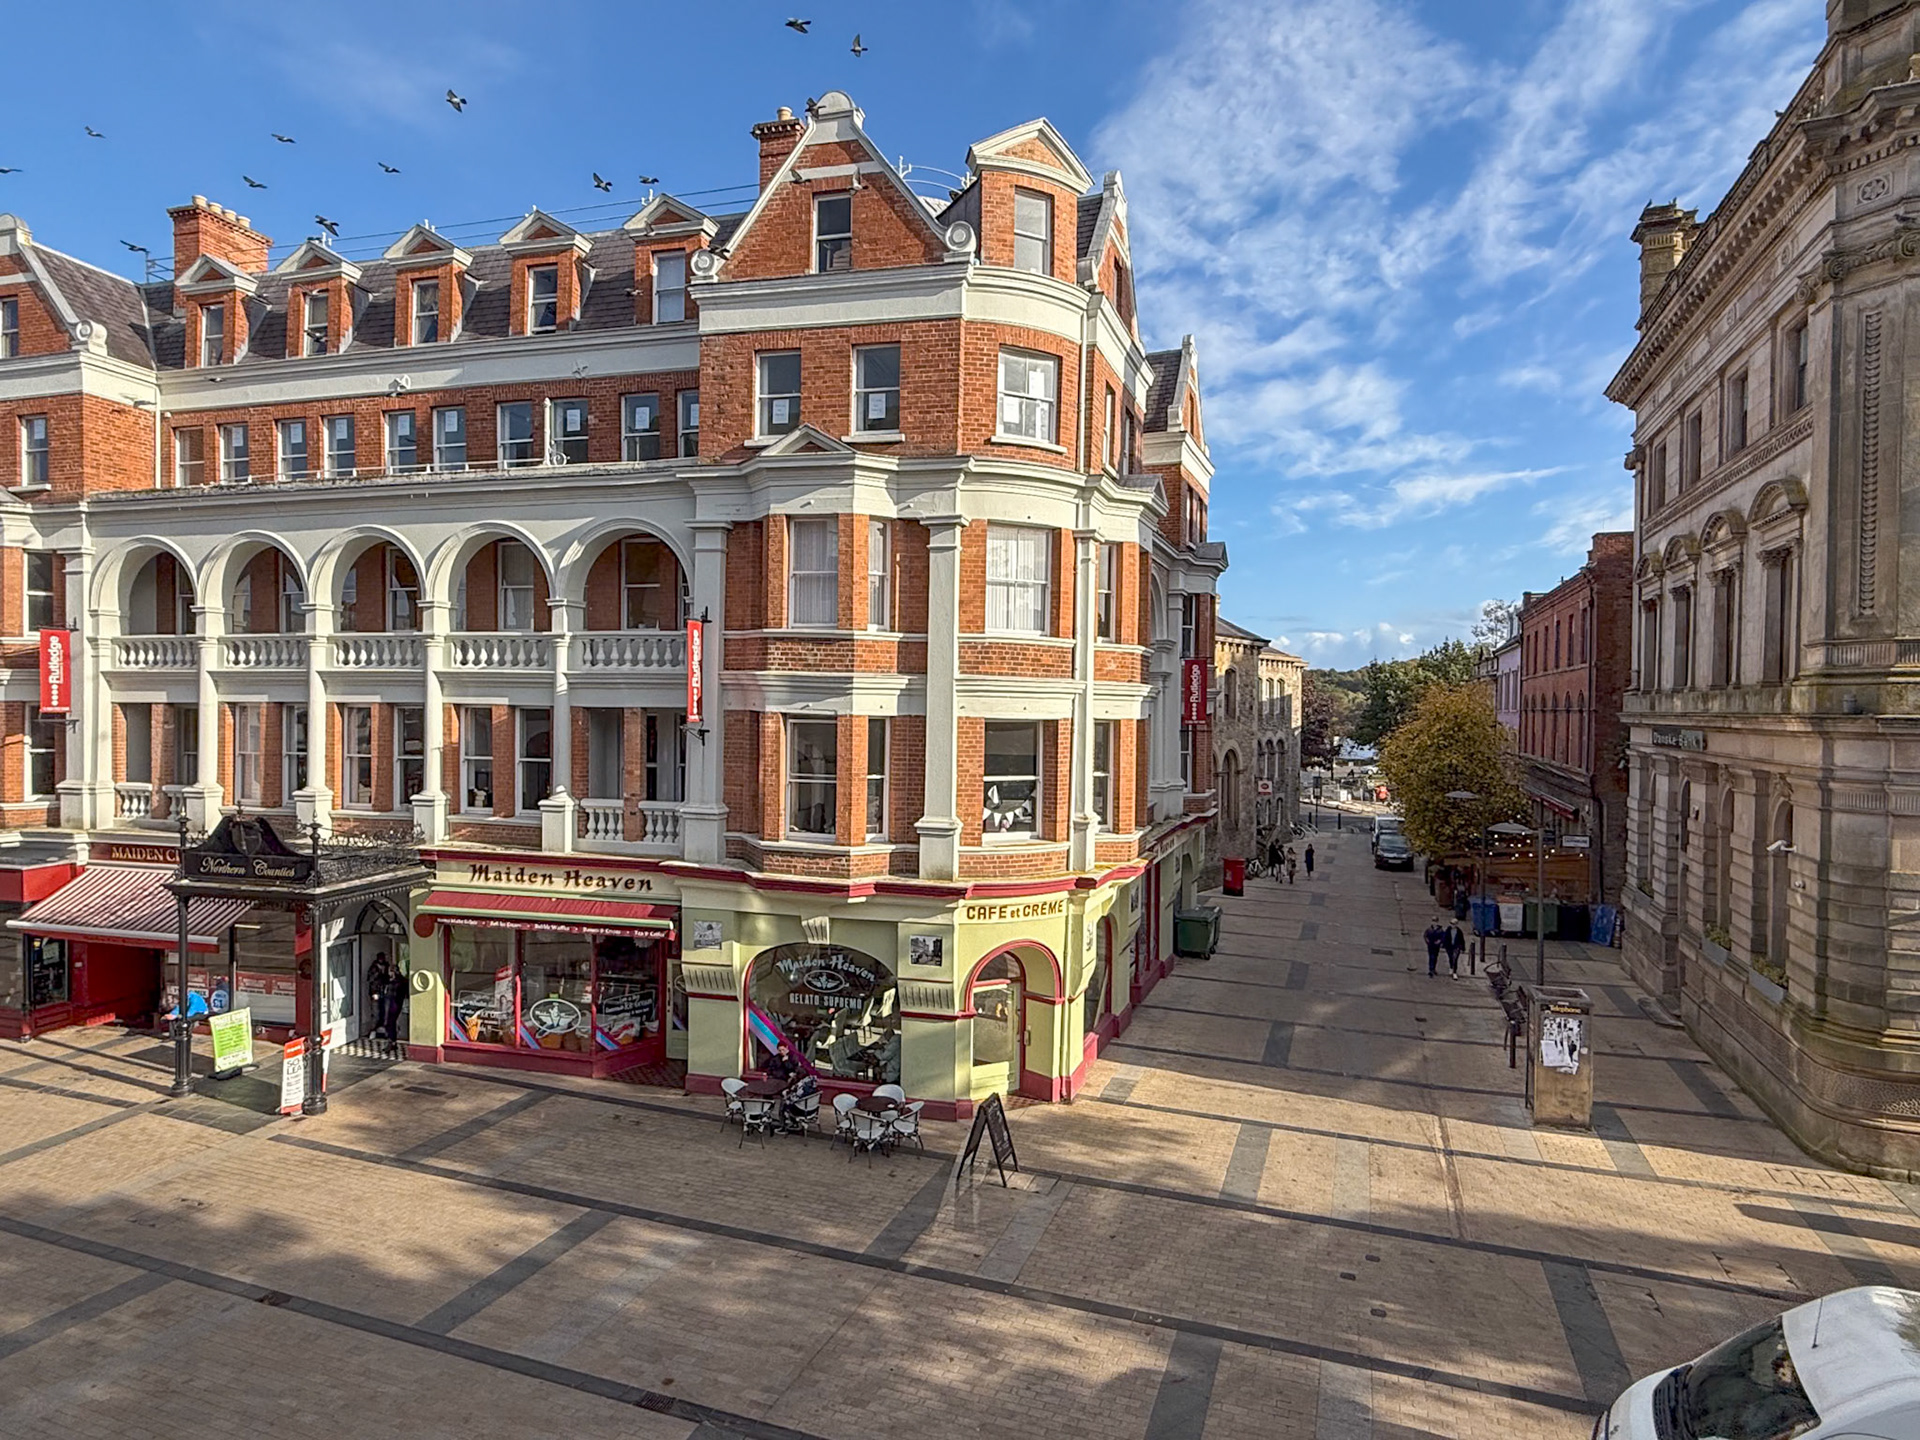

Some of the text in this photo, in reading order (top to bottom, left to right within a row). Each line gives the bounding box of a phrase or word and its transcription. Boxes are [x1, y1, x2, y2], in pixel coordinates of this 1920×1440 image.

[48, 636, 62, 684] Rutledge
[692, 629, 701, 687] Rutledge
[1190, 664, 1200, 703] Rutledge
[111, 846, 164, 861] MAIDEN
[200, 857, 296, 877] Northern Counties
[469, 864, 653, 891] Maiden Heaven
[966, 905, 1007, 920] CAFE
[1010, 908, 1020, 918] et
[776, 954, 876, 982] Maiden Heaven
[789, 993, 863, 1010] GELATO SUPREMO
[1549, 1004, 1582, 1014] Telephone
